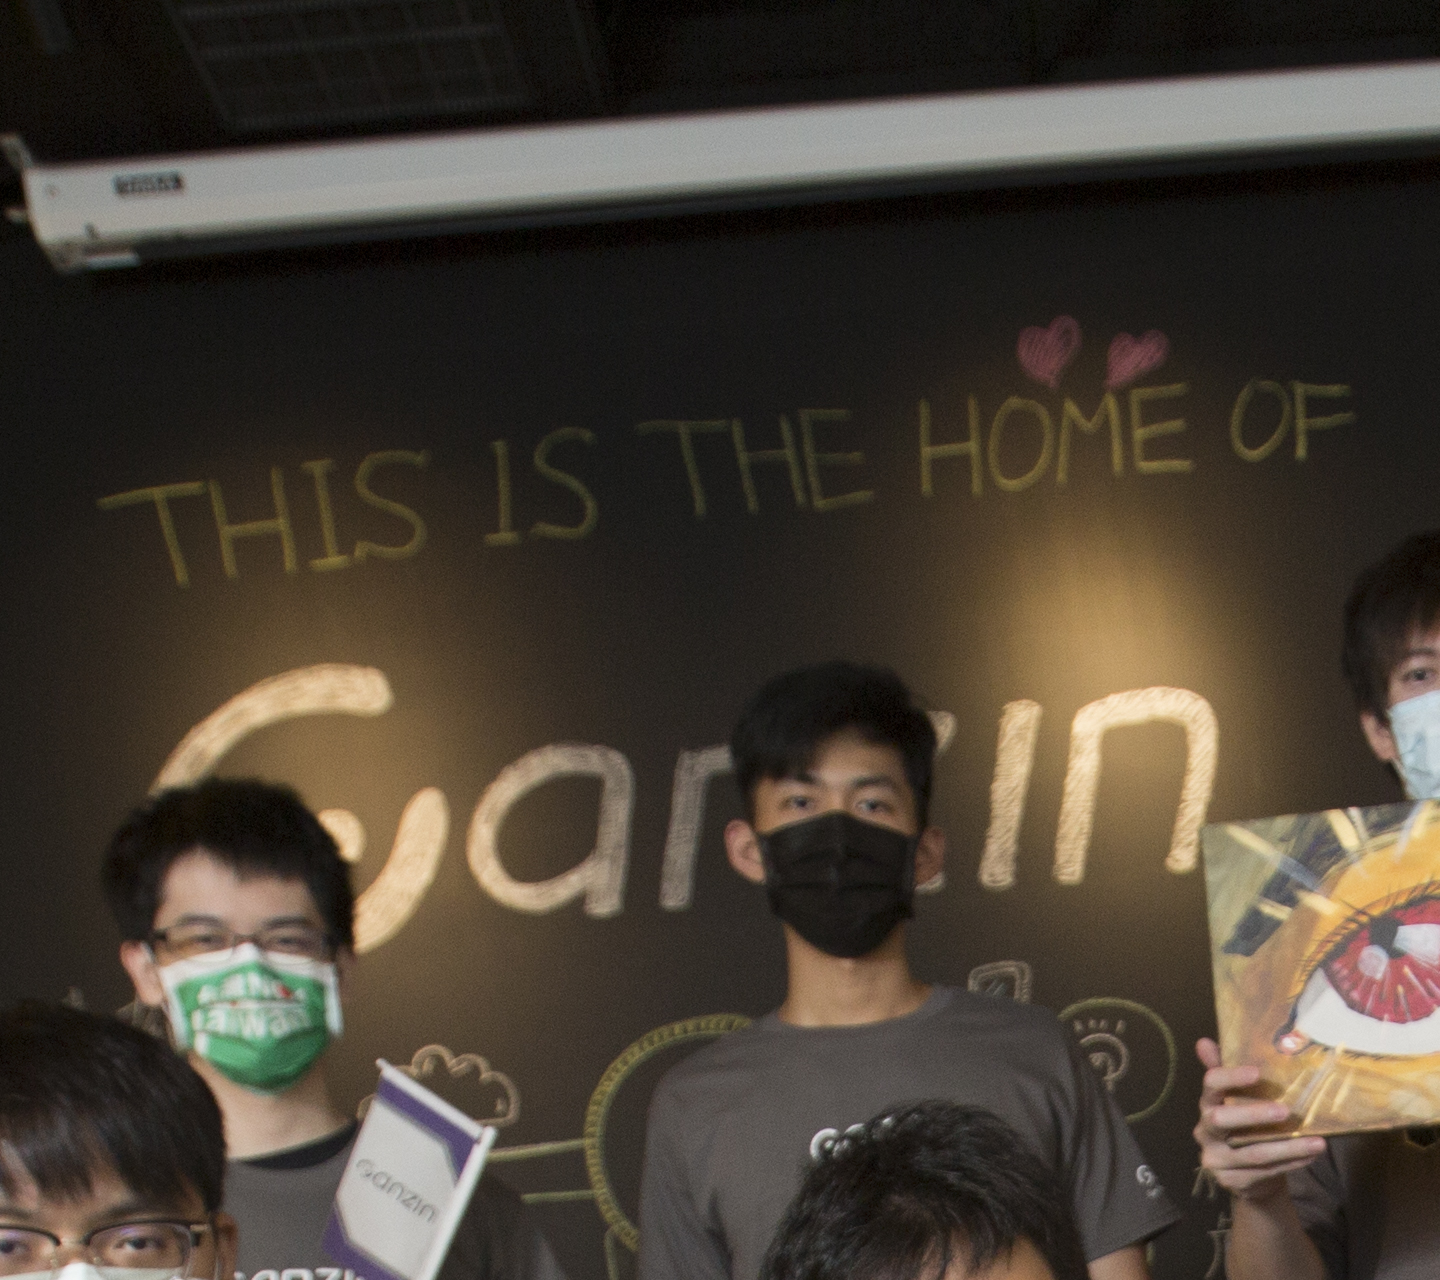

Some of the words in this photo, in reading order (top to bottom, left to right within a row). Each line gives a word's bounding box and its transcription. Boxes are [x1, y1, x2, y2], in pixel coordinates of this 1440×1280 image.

[98, 448, 432, 589] THIS
[483, 425, 600, 545] IS
[636, 405, 875, 520] THE
[918, 380, 1197, 499] HOME
[1230, 378, 1356, 464] OF
[355, 1157, 438, 1223] Ganzin
